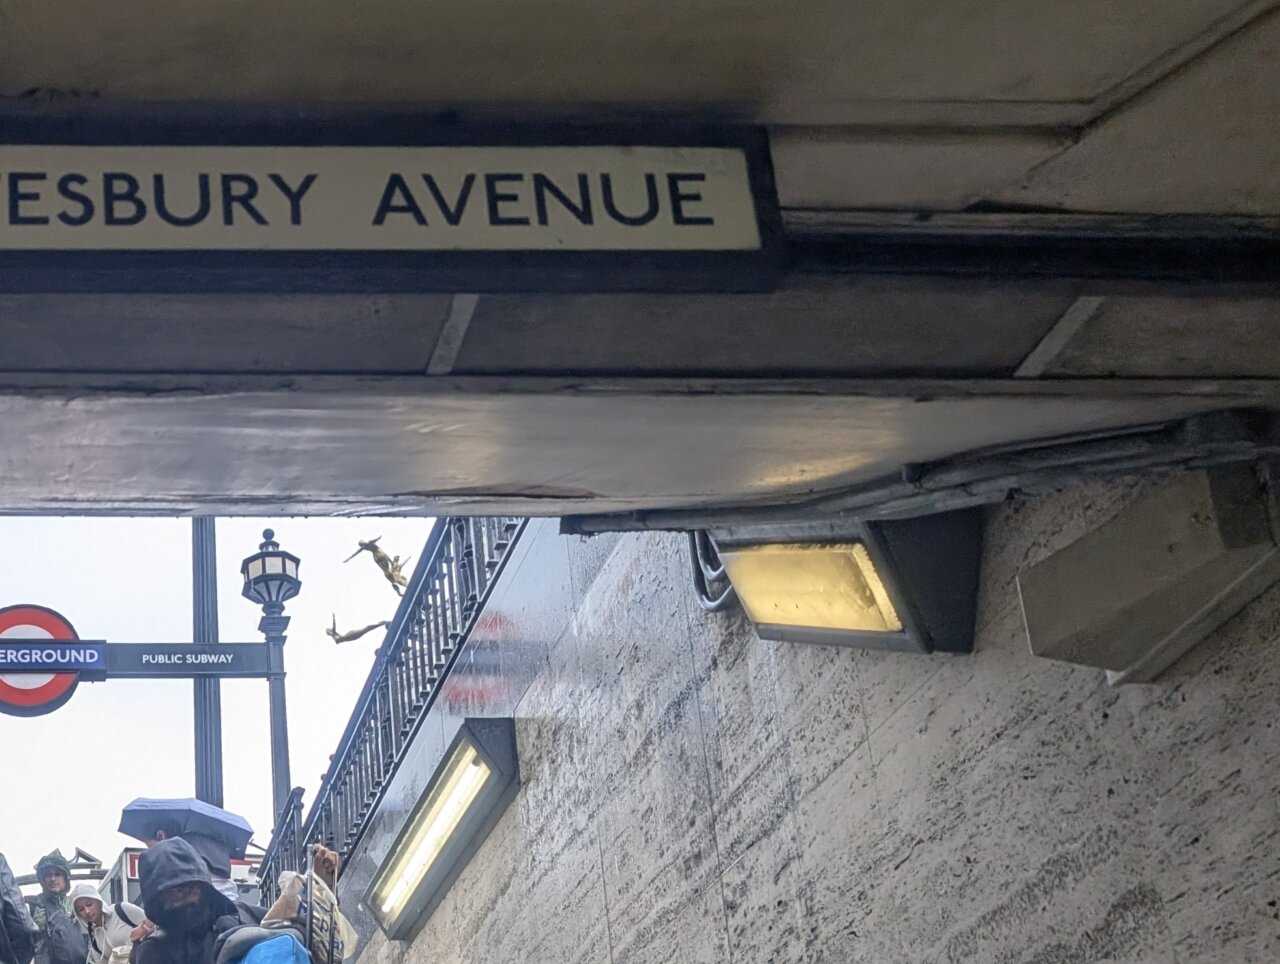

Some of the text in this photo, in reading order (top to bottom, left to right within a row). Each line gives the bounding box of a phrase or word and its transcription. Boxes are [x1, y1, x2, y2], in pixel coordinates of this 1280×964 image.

[372, 172, 714, 226] AVENUE
[142, 654, 234, 664] PUBLIC SUBWAY
